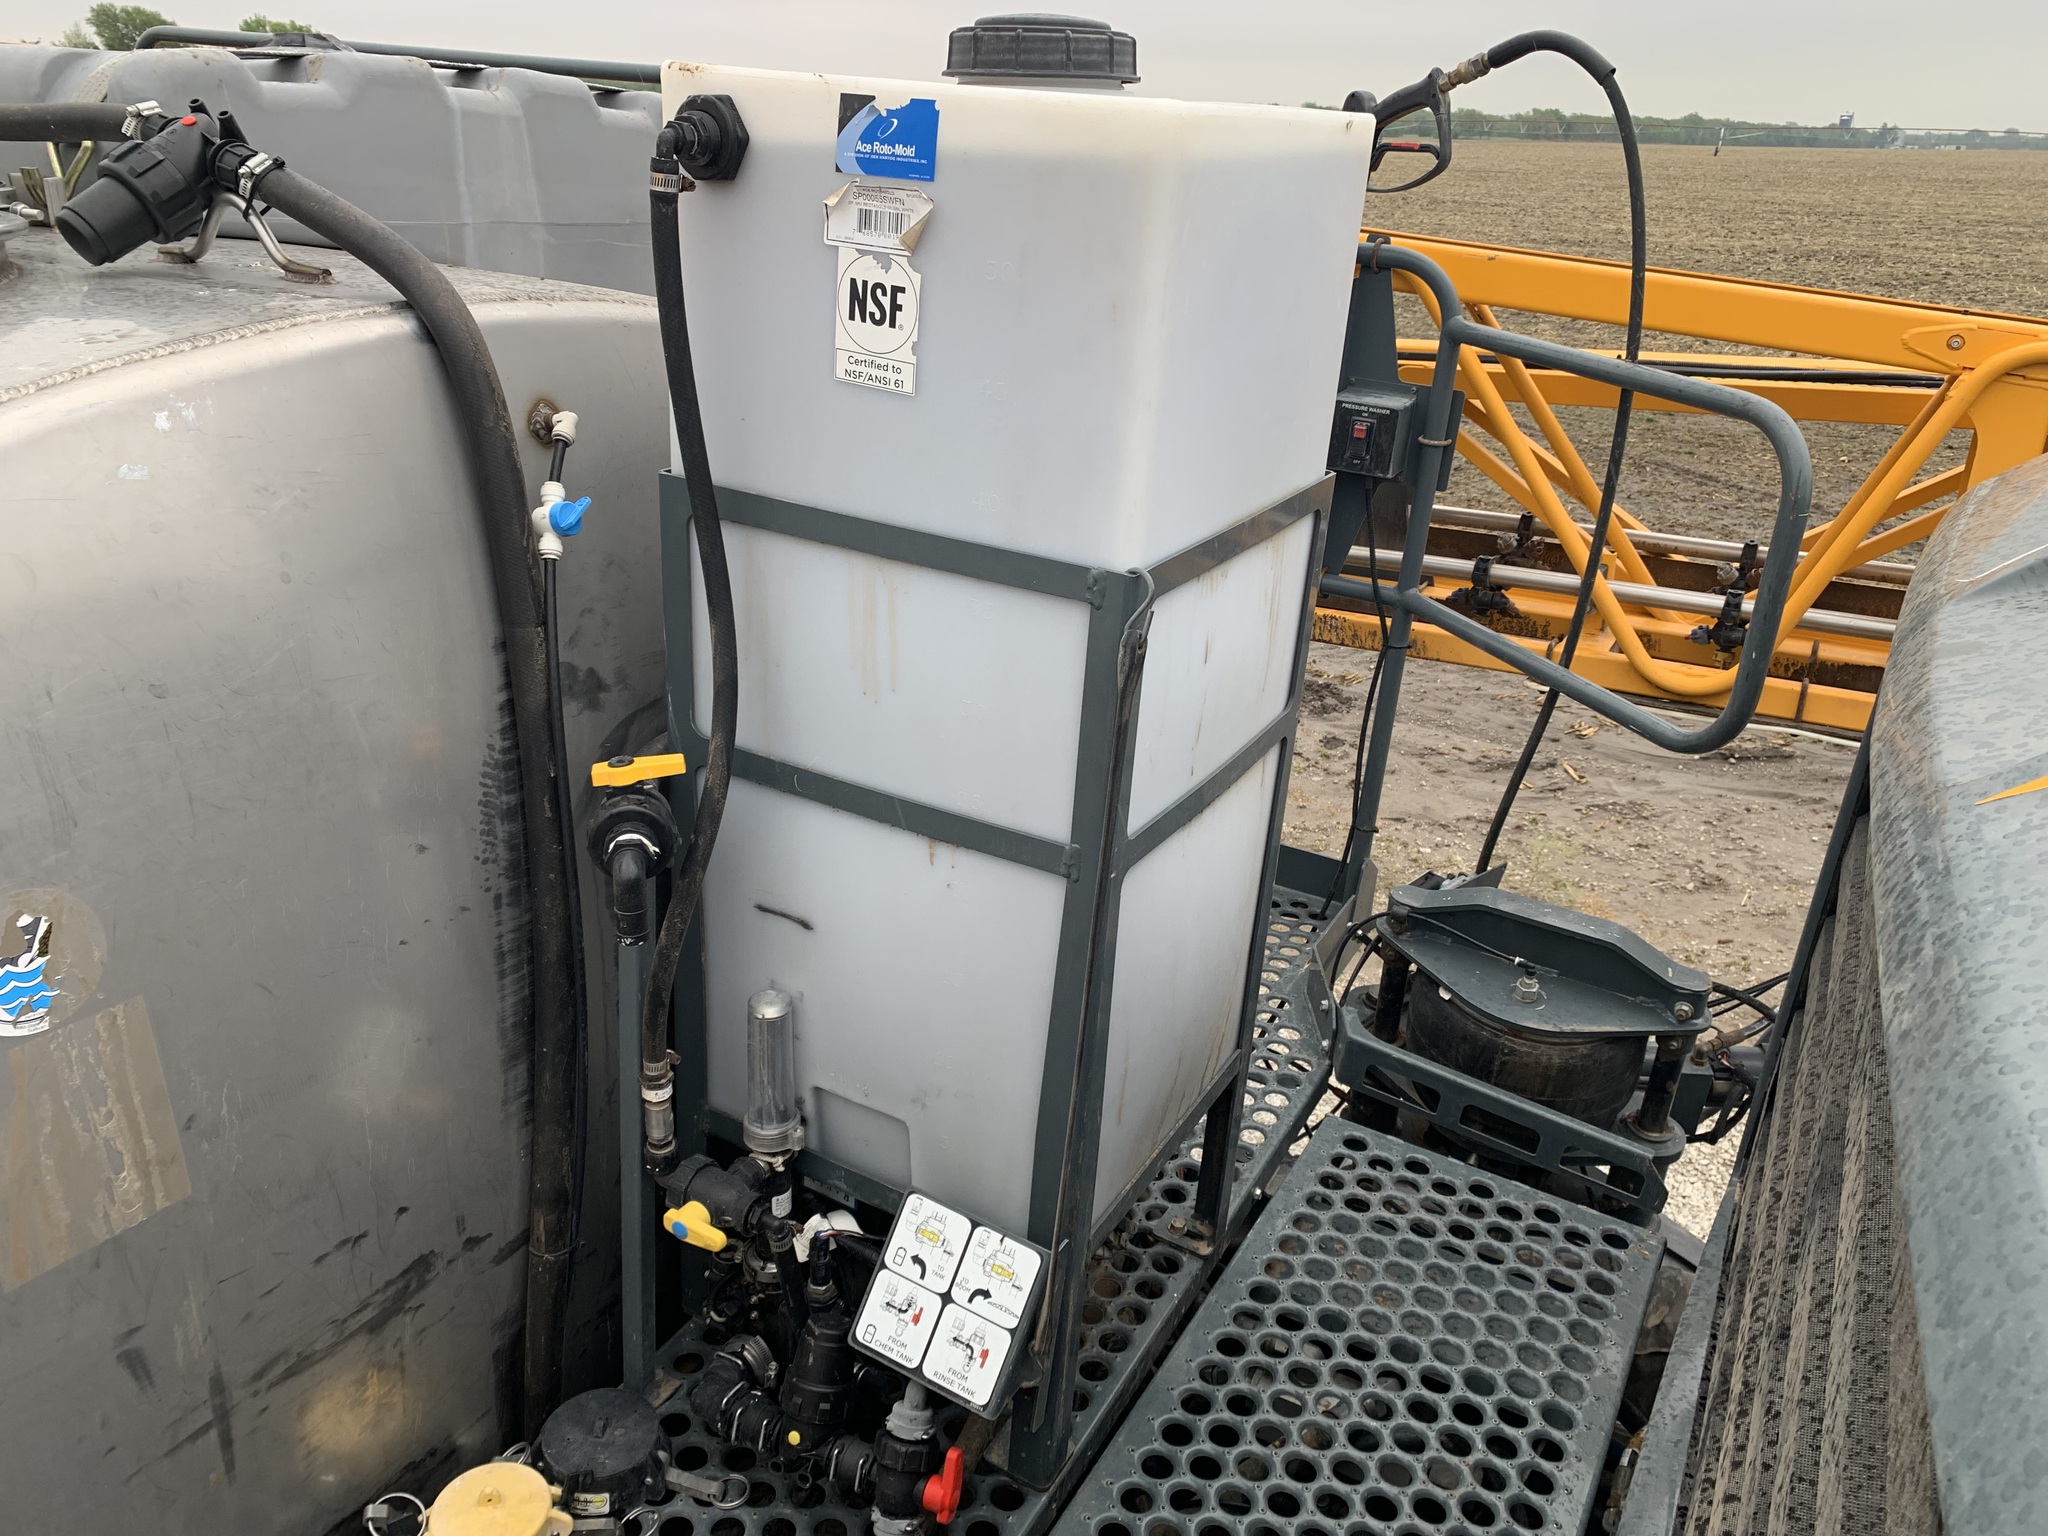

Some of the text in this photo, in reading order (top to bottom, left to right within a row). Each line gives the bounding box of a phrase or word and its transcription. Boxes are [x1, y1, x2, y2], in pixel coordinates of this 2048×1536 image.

[856, 140, 915, 157] Ace Roto-Mold
[848, 277, 906, 329] NSF
[847, 355, 902, 375] Certified to
[844, 368, 904, 389] NSF/ANSI 61
[1341, 402, 1391, 415] PRESSURE WASHER
[931, 1270, 946, 1281] TANK
[962, 1277, 970, 1285] TO
[955, 1281, 971, 1293] BOOM
[887, 1335, 908, 1351] FROM
[874, 1339, 914, 1365] CHEM TANK
[947, 1367, 969, 1383] FROM
[932, 1371, 976, 1399] RINSE TANK
